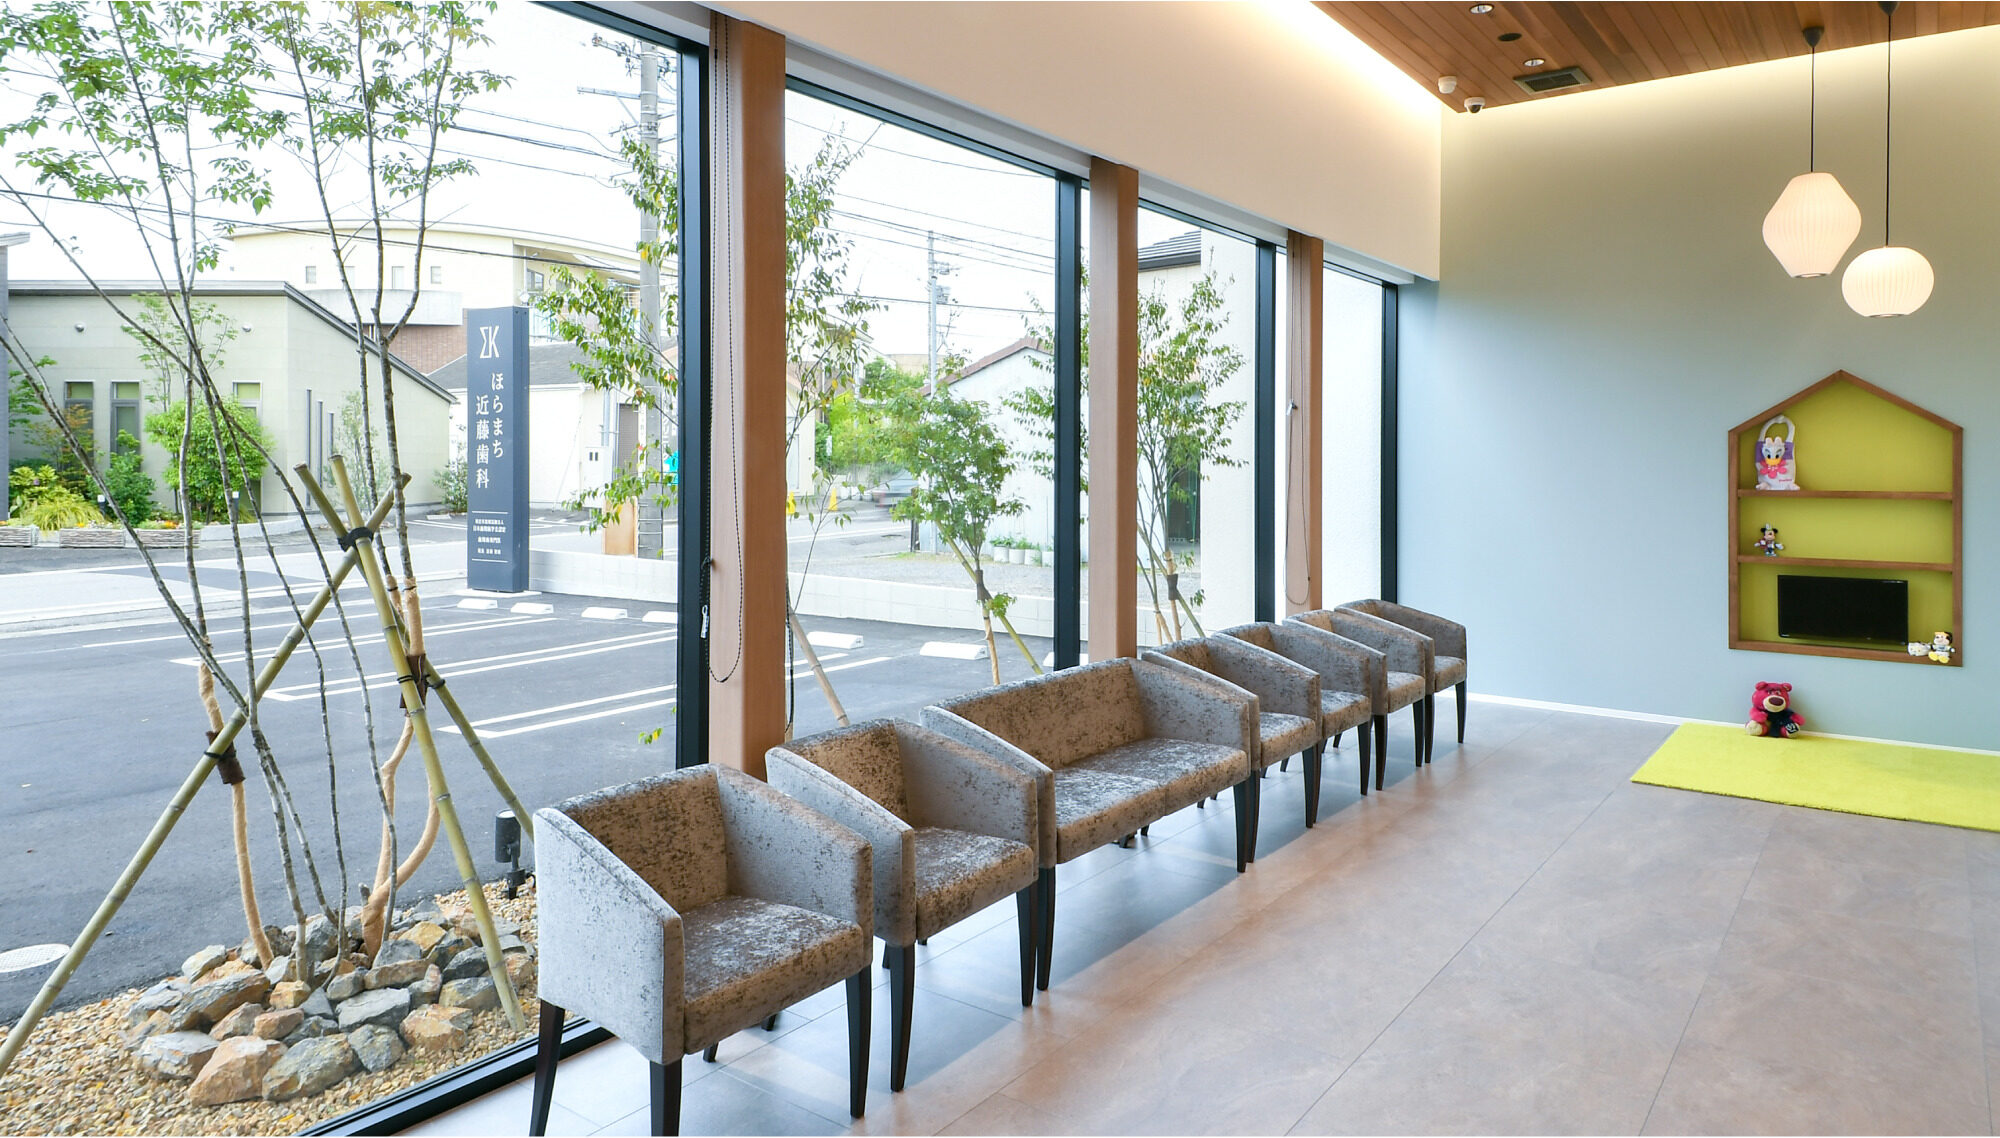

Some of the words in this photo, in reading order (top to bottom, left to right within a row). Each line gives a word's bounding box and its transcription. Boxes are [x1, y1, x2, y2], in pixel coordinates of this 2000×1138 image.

[475, 394, 490, 489] 近藤歯科
[491, 372, 504, 458] ほらまち
